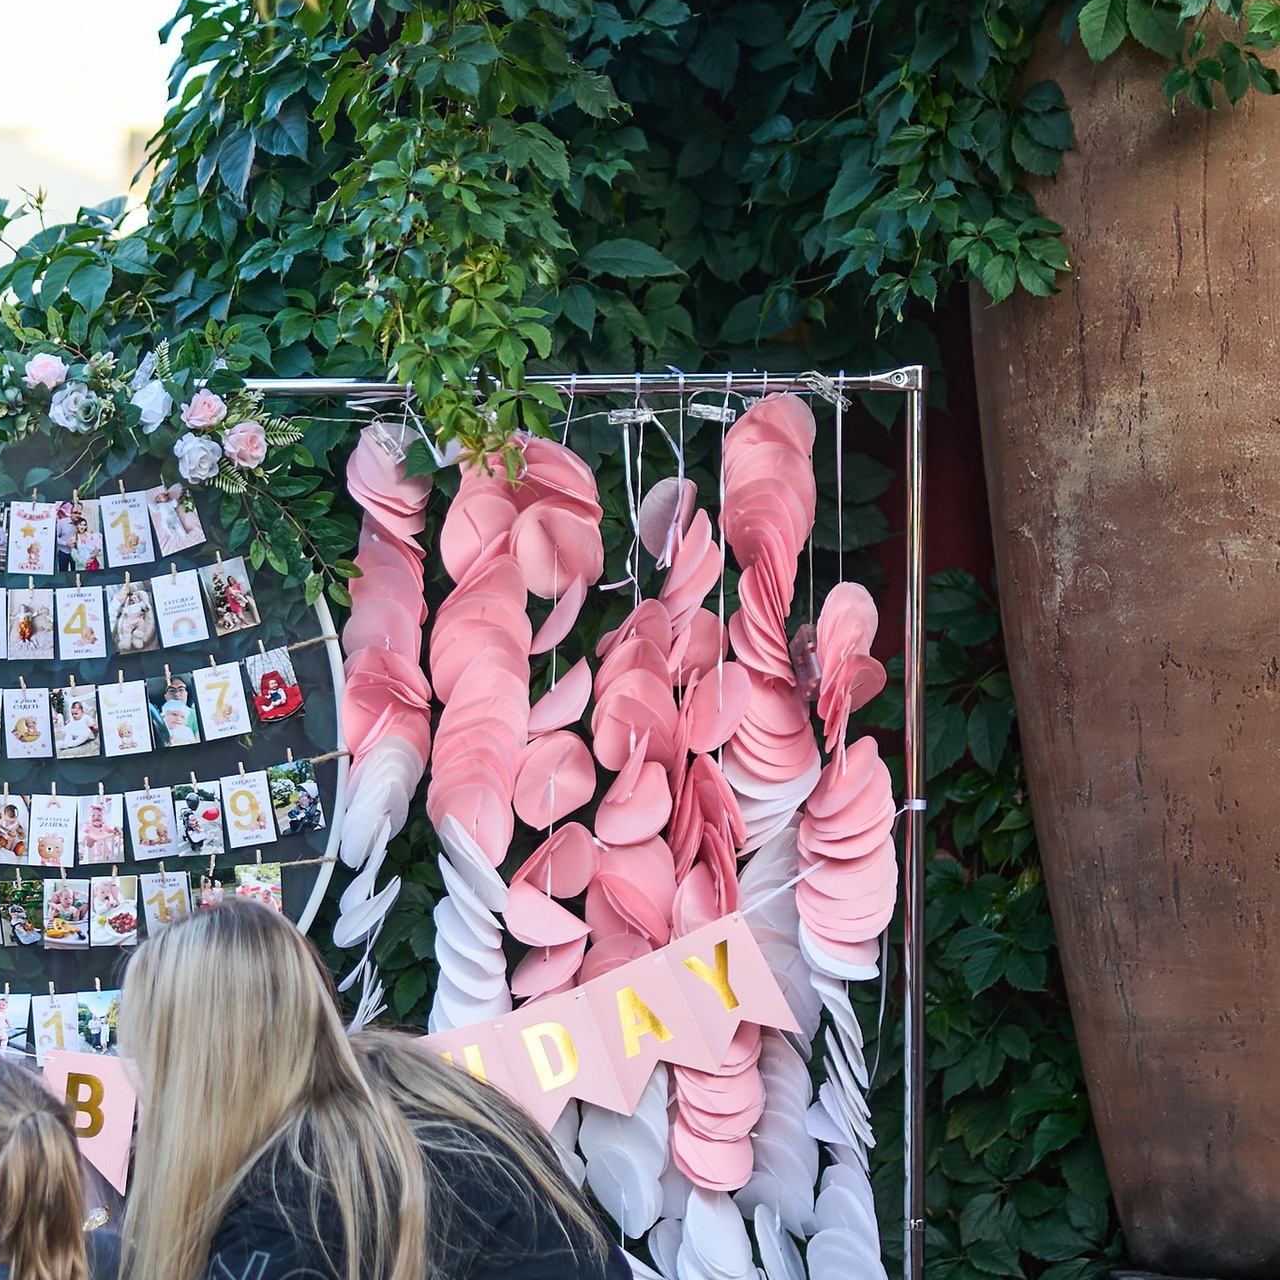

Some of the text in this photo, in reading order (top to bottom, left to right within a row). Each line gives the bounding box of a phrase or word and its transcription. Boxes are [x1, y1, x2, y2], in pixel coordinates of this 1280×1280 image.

[110, 510, 131, 549] 1
[63, 603, 87, 639] 4
[205, 681, 230, 717] 7
[137, 805, 161, 843] 8
[230, 790, 259, 830] 9
[147, 888, 186, 924] 11
[43, 1011, 65, 1050] 1
